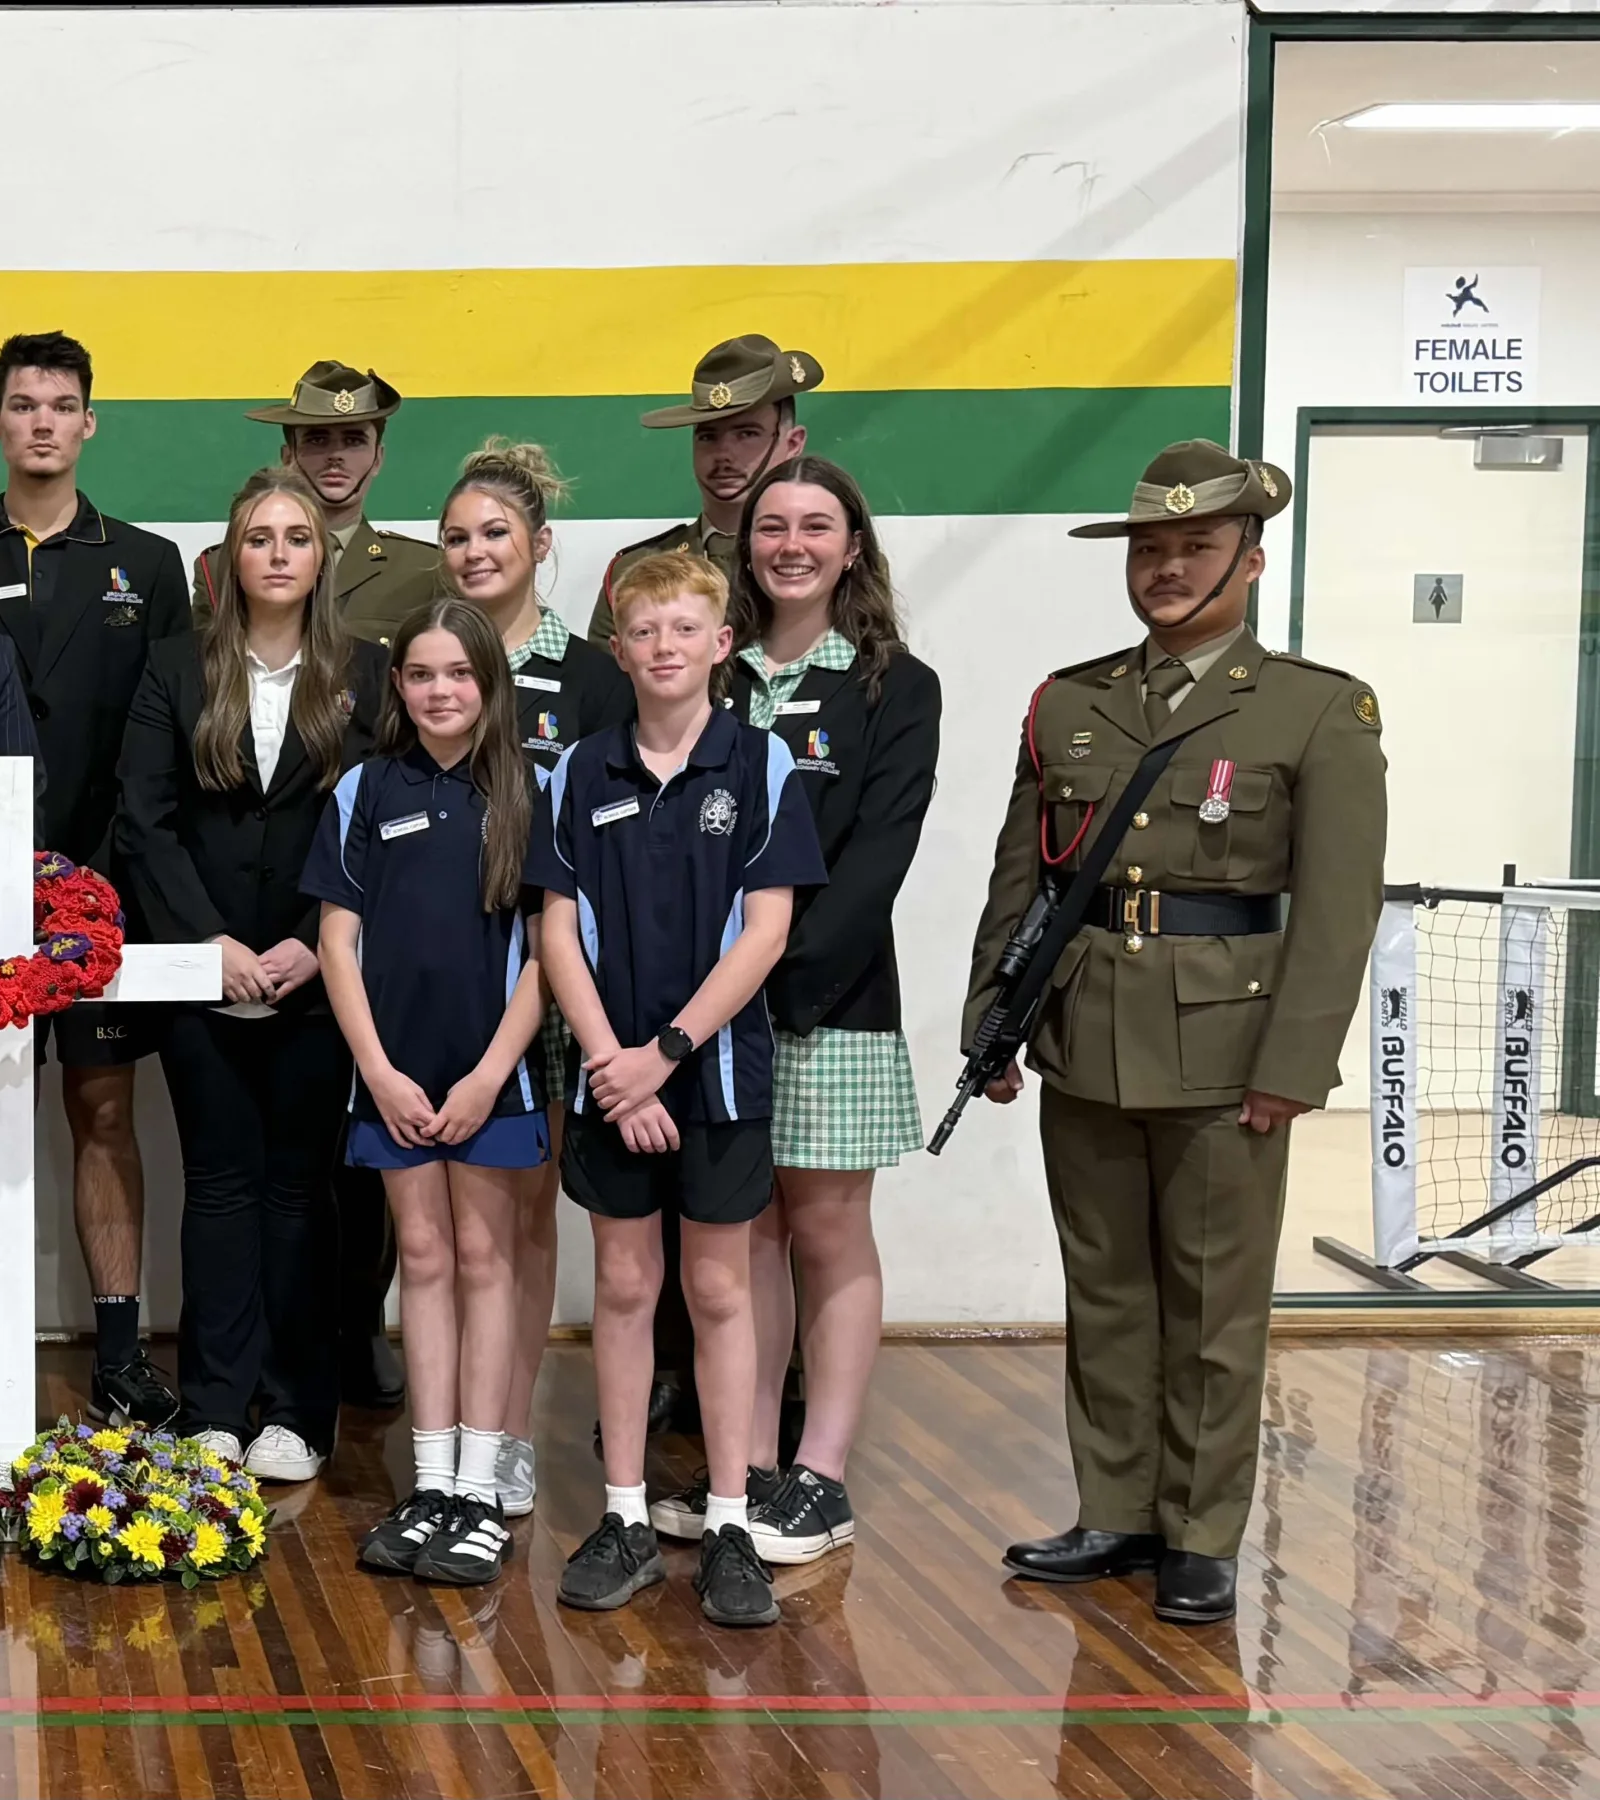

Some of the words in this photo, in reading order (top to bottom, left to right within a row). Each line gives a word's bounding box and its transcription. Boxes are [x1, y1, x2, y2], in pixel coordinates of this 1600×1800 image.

[1415, 339, 1522, 361] FEMALE
[1413, 371, 1523, 393] TOILETS
[1380, 988, 1389, 1028] SPORTS
[1400, 986, 1408, 1031] BUFFALO
[1381, 1036, 1406, 1168] BUFFALO
[1501, 1036, 1530, 1169] BUFFALO
